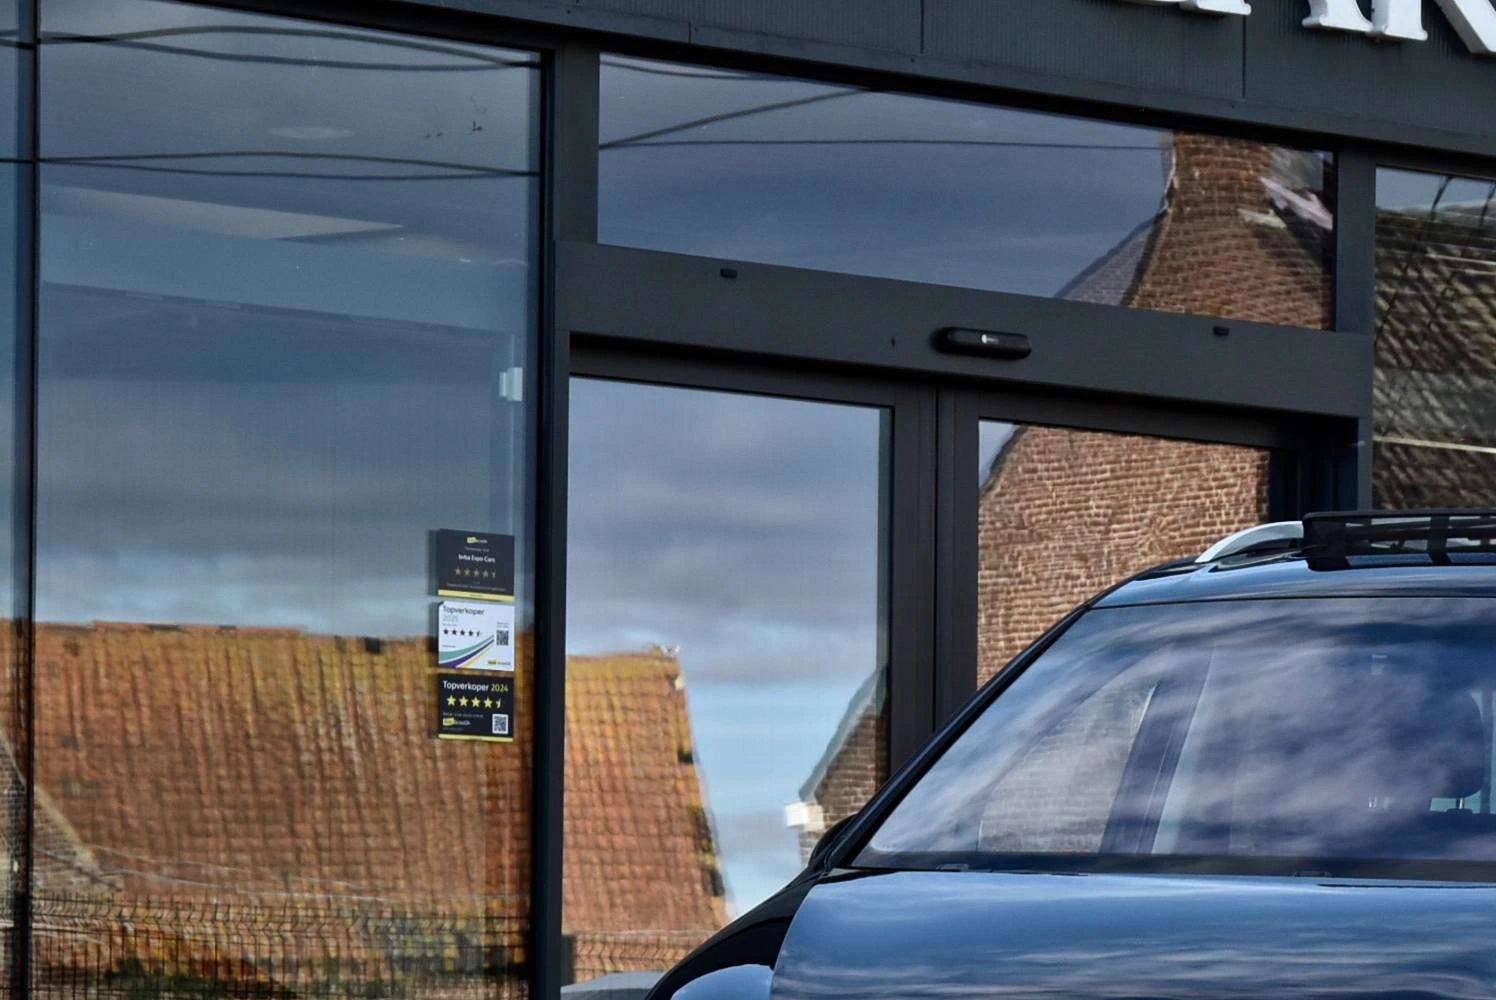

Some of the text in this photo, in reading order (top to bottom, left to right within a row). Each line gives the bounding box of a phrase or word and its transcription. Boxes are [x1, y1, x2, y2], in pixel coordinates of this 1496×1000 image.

[443, 605, 485, 616] Topverkoper
[443, 680, 509, 692] Topverkoper 2024
